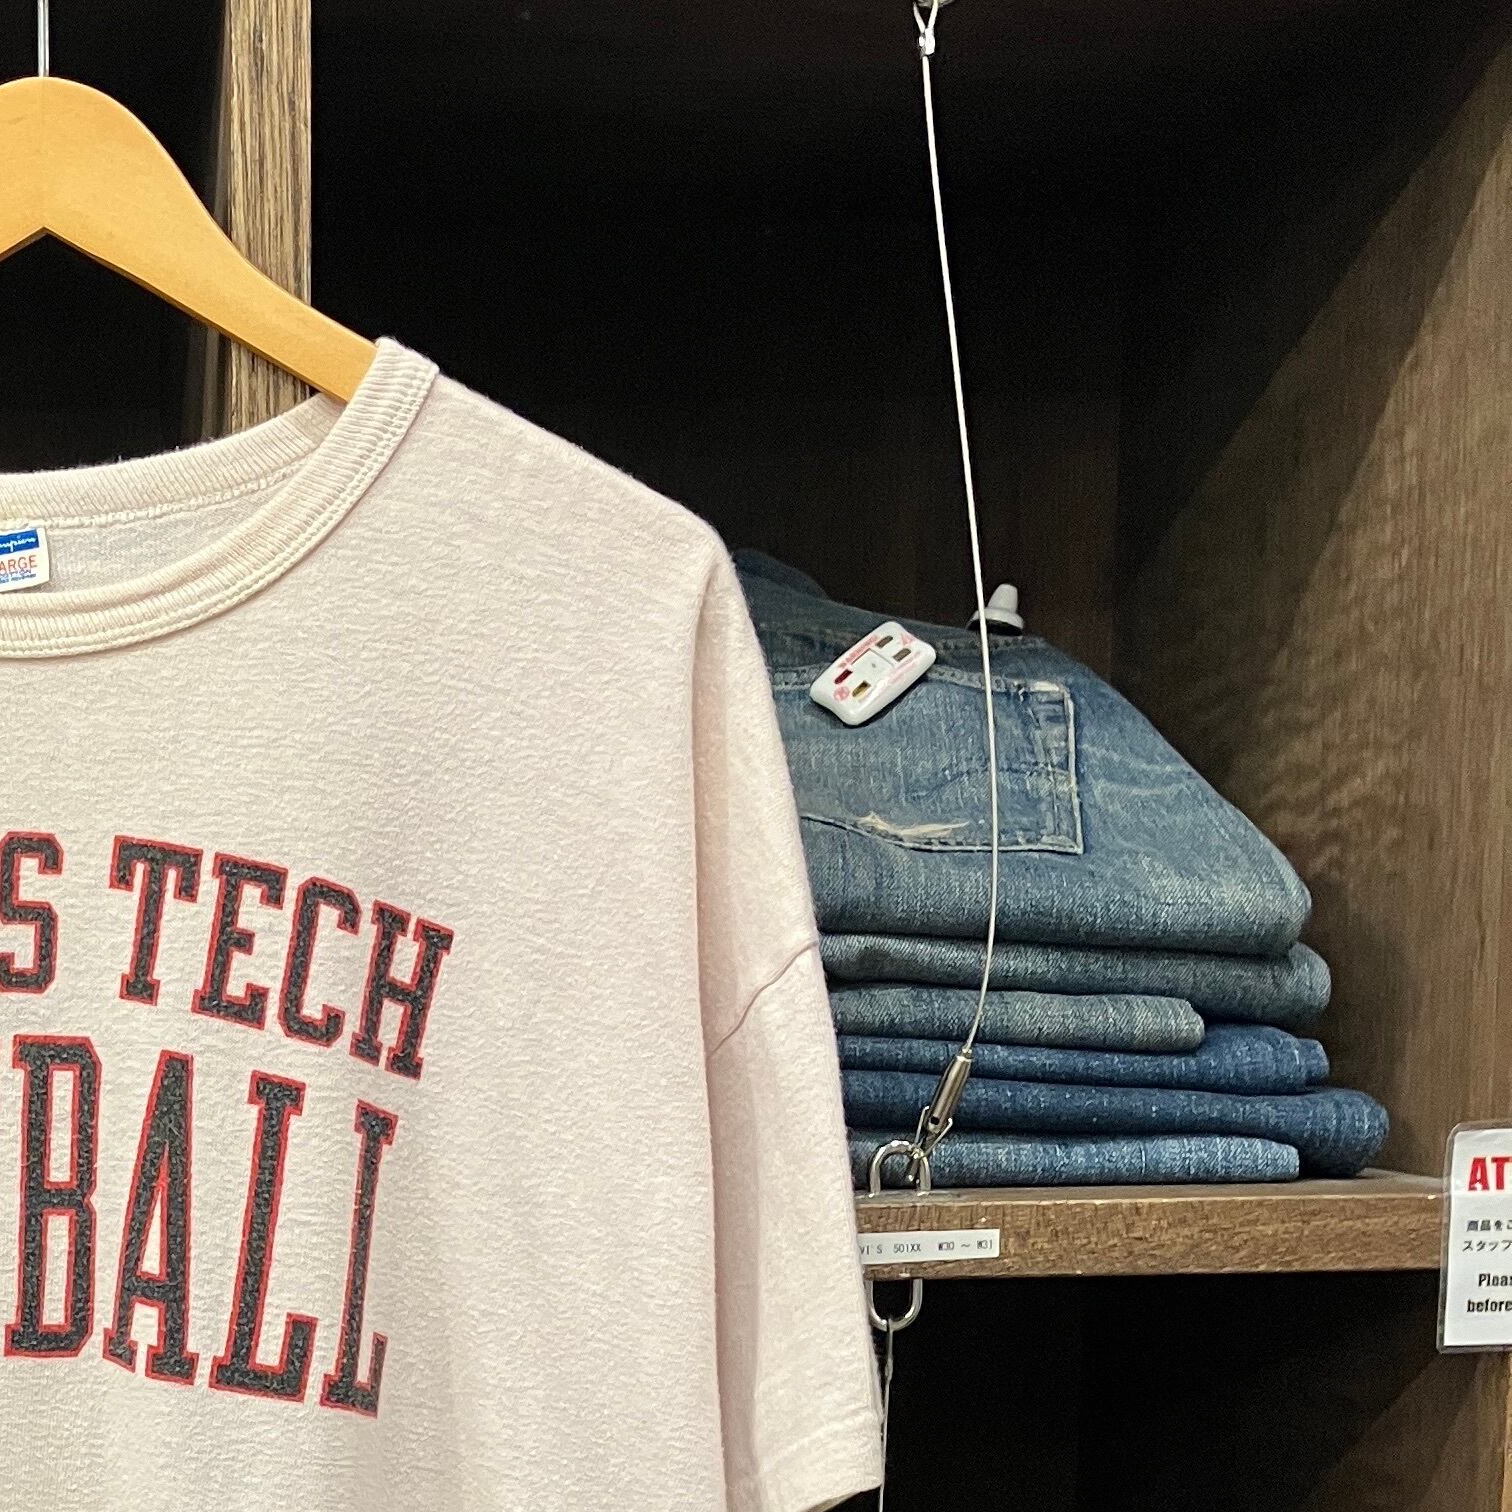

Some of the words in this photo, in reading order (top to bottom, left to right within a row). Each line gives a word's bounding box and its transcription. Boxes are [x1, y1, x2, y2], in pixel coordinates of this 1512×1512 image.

[109, 834, 454, 1080] TECH
[1467, 1156, 1512, 1191] AT
[893, 1243, 921, 1253] 501XX
